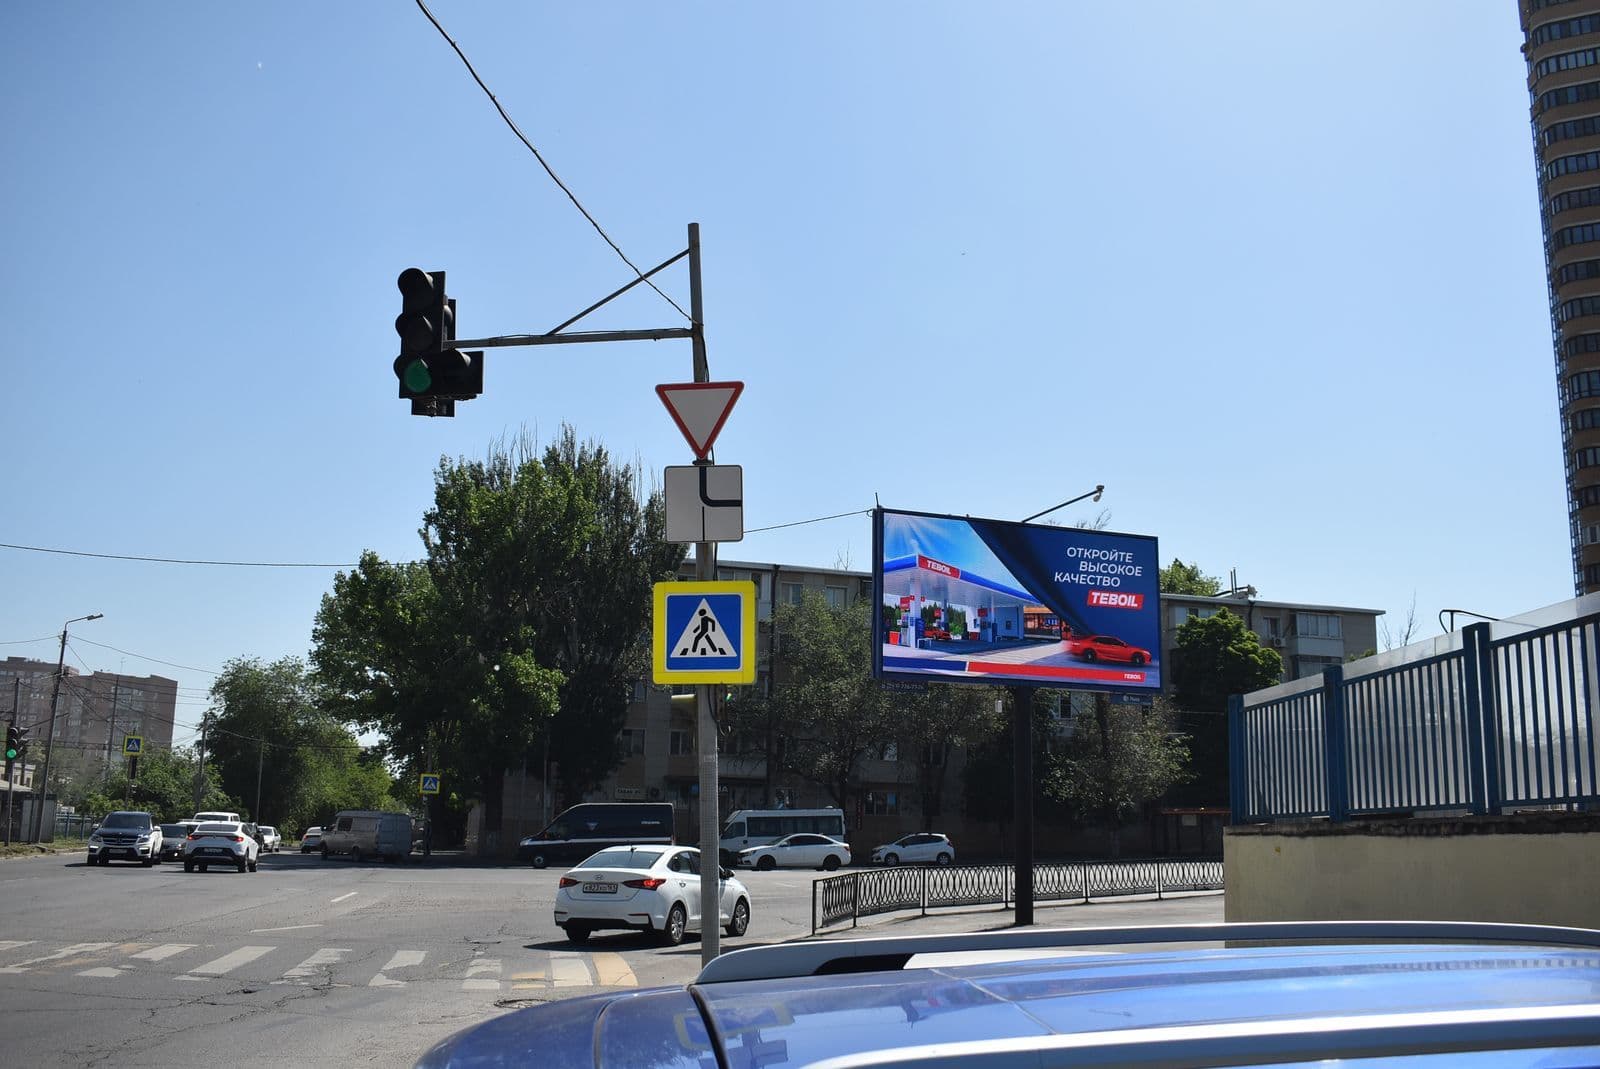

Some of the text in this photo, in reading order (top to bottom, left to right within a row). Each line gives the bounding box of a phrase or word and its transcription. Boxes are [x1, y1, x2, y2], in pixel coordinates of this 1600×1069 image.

[1066, 547, 1134, 563] ОТКРОЙТЕ
[927, 560, 952, 575] TEBOIL
[1079, 561, 1143, 577] ВЫСОКОЕ
[1054, 572, 1121, 587] КАЧЕСТВО
[1091, 592, 1138, 607] TEBOIL
